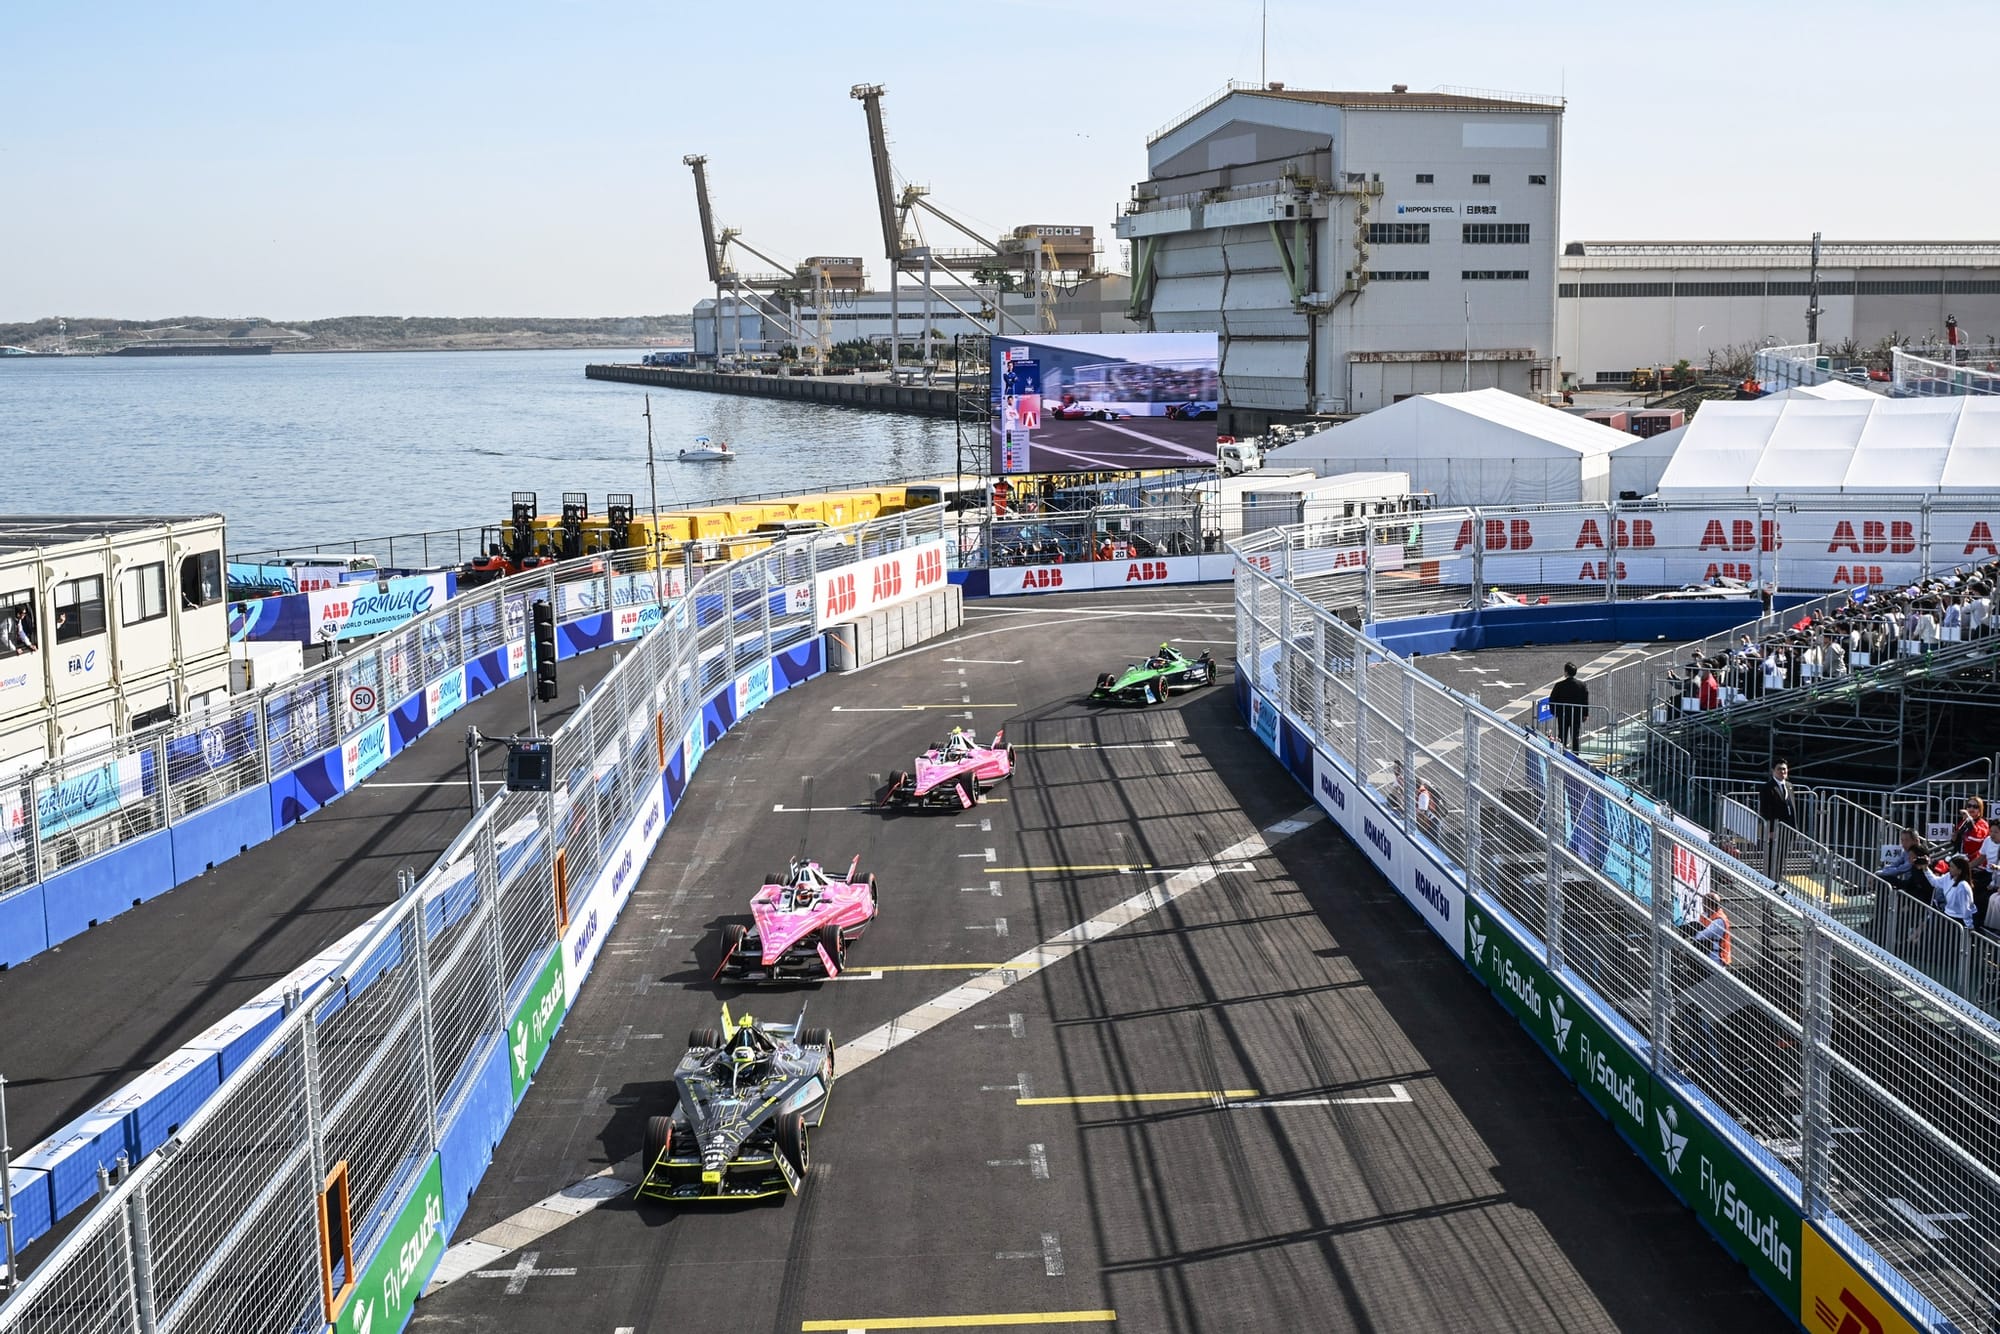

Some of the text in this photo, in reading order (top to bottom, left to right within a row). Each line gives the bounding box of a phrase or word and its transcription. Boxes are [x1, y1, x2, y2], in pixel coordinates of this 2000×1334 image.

[1466, 205, 1497, 215] 日鉄物流
[1453, 520, 1534, 550] ABB
[1575, 519, 1656, 549] ABB
[1698, 520, 1783, 551] ABB
[1827, 521, 1915, 554] ABB
[872, 560, 901, 602] ABB
[915, 549, 942, 588] ABB
[1022, 568, 1063, 589] ABB
[1126, 562, 1168, 582] ABB
[1578, 562, 1627, 580] ABB
[1704, 563, 1752, 581] ABB
[1833, 565, 1884, 584] ABB
[323, 602, 349, 620] ABB
[350, 590, 414, 618] FORMULA
[826, 573, 856, 618] ABB
[340, 621, 361, 630] WORLD
[363, 613, 411, 625] CHAMPIONSHIP
[621, 612, 637, 624] ABB
[355, 694, 370, 705] 50
[1321, 772, 1345, 811] KOMATSU
[643, 801, 659, 842] KOMATSU
[1364, 816, 1391, 861] KOMATSU
[612, 849, 632, 897] KOMATSU
[1415, 868, 1450, 922] KOMATSU
[574, 908, 598, 968] KOMATSU
